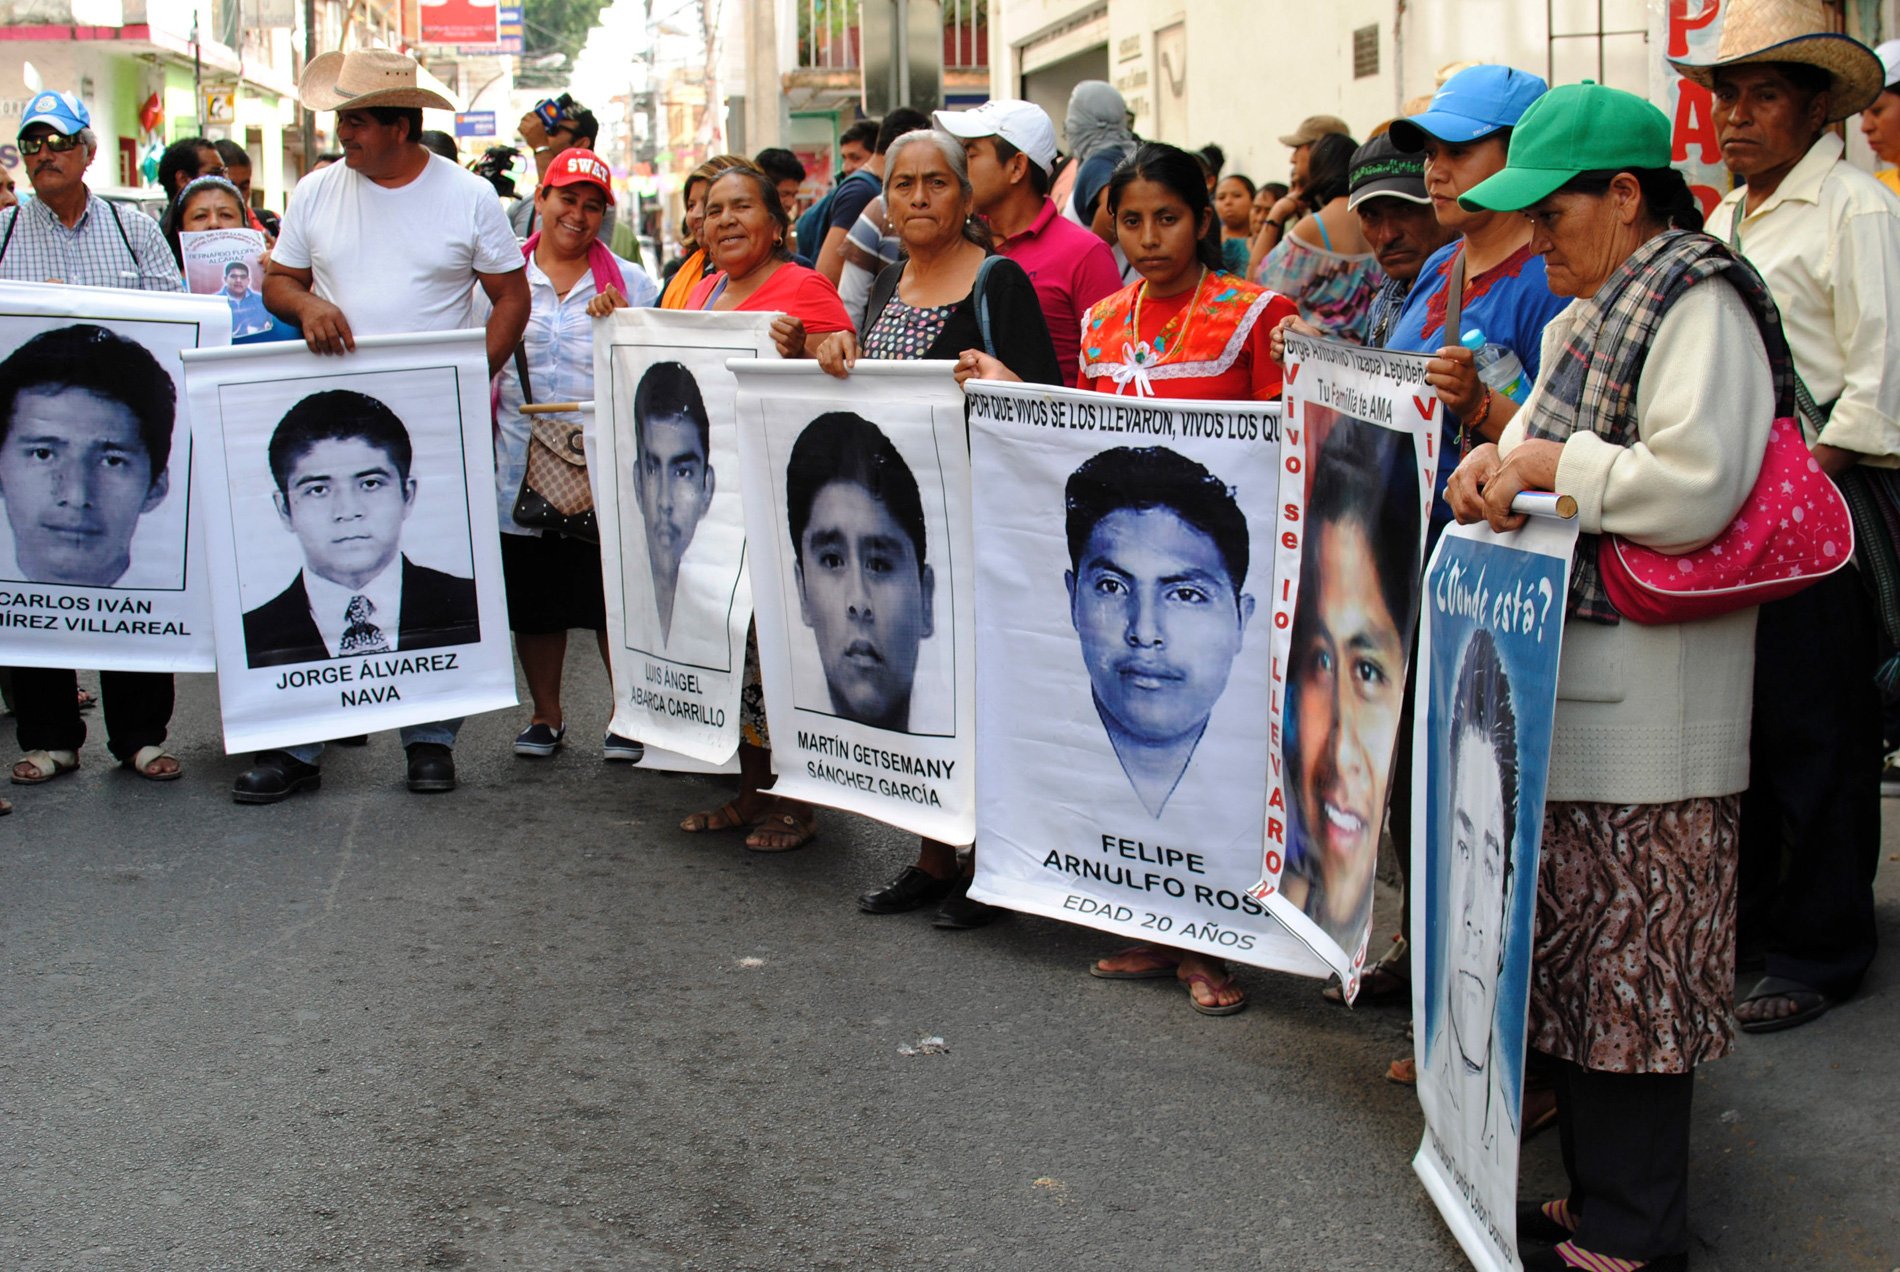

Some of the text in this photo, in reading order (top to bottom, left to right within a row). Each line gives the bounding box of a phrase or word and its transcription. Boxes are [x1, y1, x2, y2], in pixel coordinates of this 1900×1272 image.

[567, 158, 608, 183] SWAT
[1286, 339, 1310, 362] orge
[1309, 340, 1349, 367] Antonio
[1350, 349, 1382, 380] Tizapa
[968, 393, 991, 419] POR
[991, 395, 1014, 423] QUE
[1013, 398, 1048, 427] VIVOS
[1050, 400, 1066, 429] SE
[1069, 403, 1096, 431] LOS
[1099, 405, 1177, 441] LLEVARON,
[1180, 411, 1225, 439] VIVOS
[1228, 413, 1259, 441] LOS
[1318, 378, 1393, 425] Tu Familia te AMA
[0, 591, 152, 614] CARLOS IVÁN
[1436, 555, 1554, 644] ¿Dónde está?
[0, 610, 191, 636] ÍREZ VILLAREAL
[276, 653, 459, 690] JORGE ÁLVAREZ
[645, 661, 703, 695] LUIS ÁNGEL
[341, 685, 401, 707] NAVA
[631, 686, 725, 728] ABARCA CARRILLO
[797, 730, 955, 780] MARTÍN GETSEMANY
[807, 759, 942, 808] SÁNCHEZ GARCÍA
[1043, 850, 1185, 898] ARNULFO
[1101, 834, 1206, 875] FELIPE
[1062, 894, 1257, 951] EDAD 20 AÑOS
